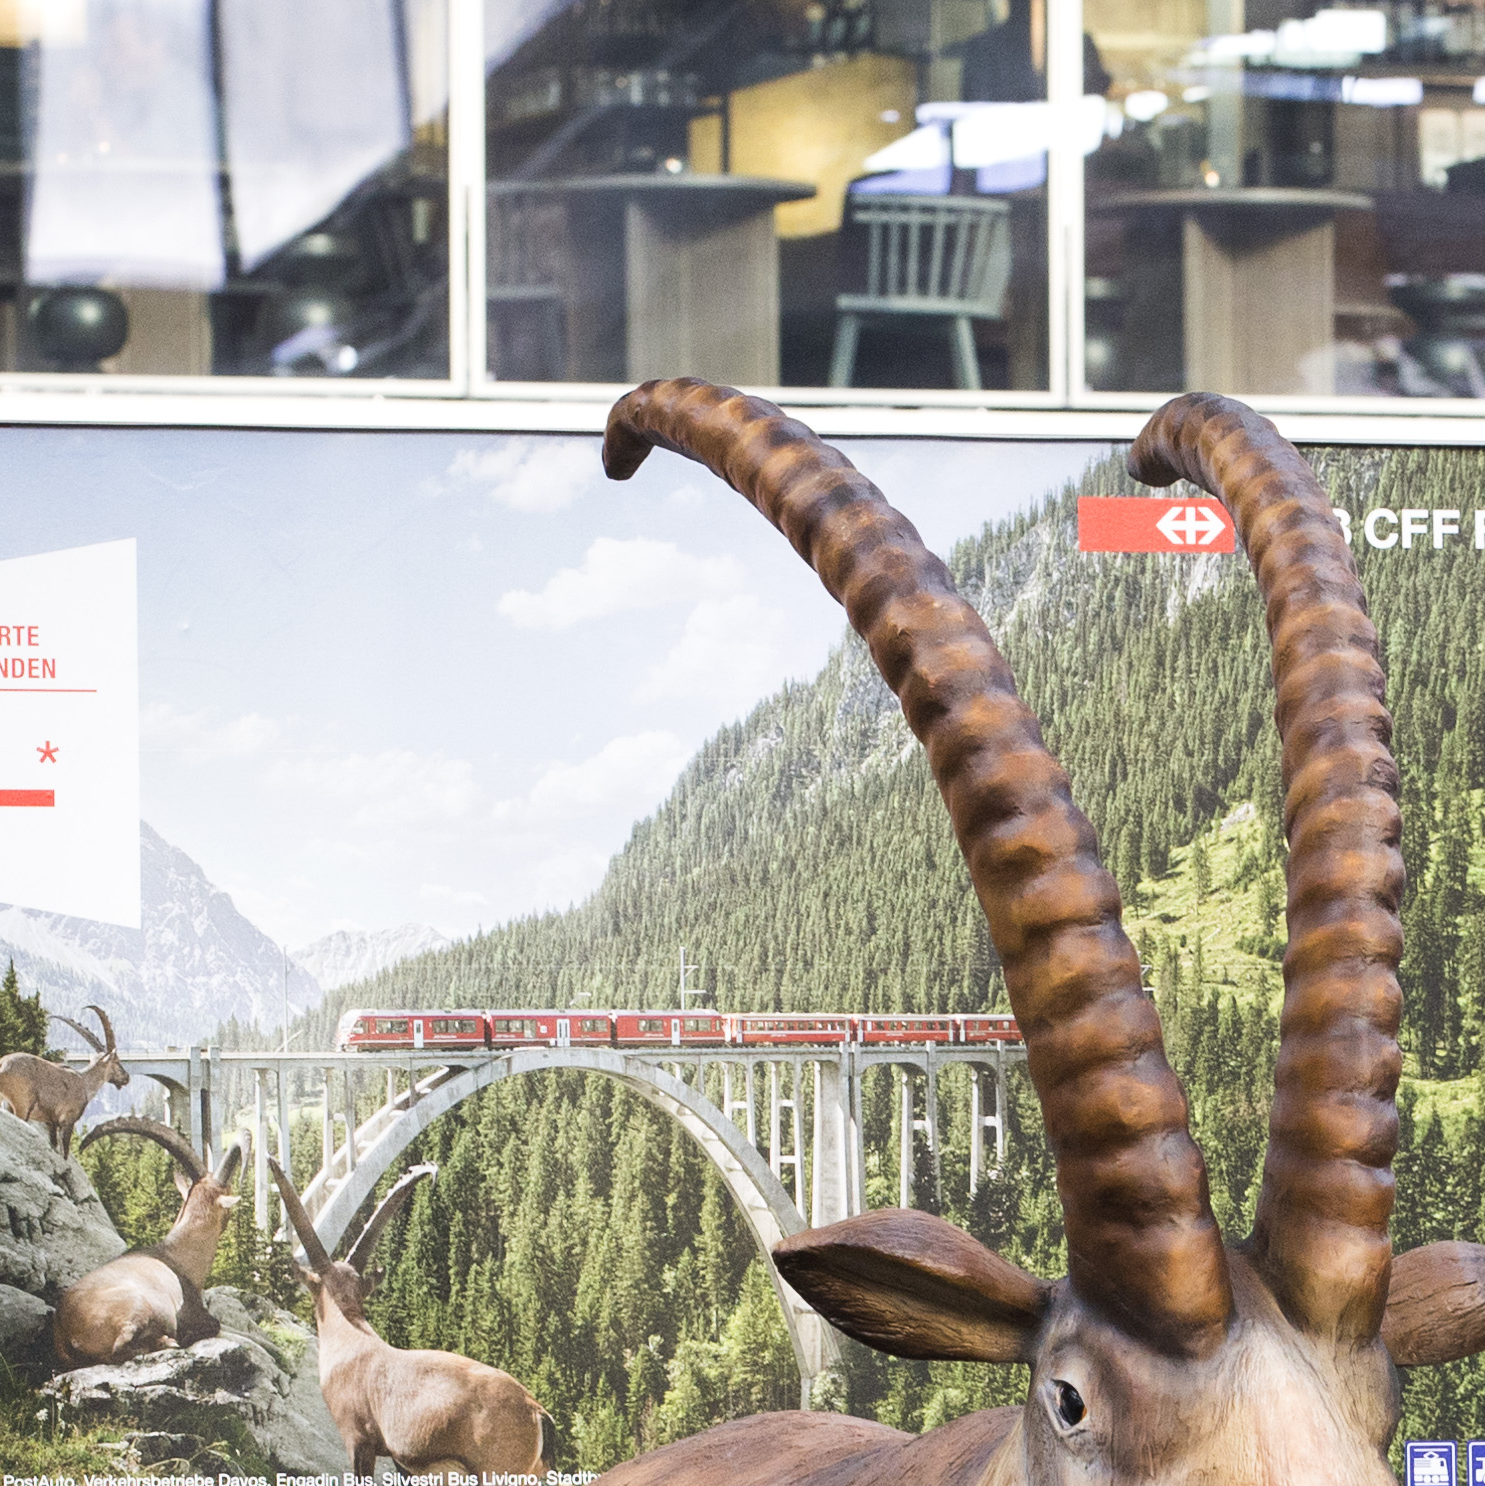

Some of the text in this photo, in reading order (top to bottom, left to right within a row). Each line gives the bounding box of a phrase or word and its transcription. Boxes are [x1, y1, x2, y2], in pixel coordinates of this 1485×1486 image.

[1364, 508, 1460, 548] CFF
[381, 1472, 444, 1486] Silvestri
[447, 1472, 478, 1486] Bus
